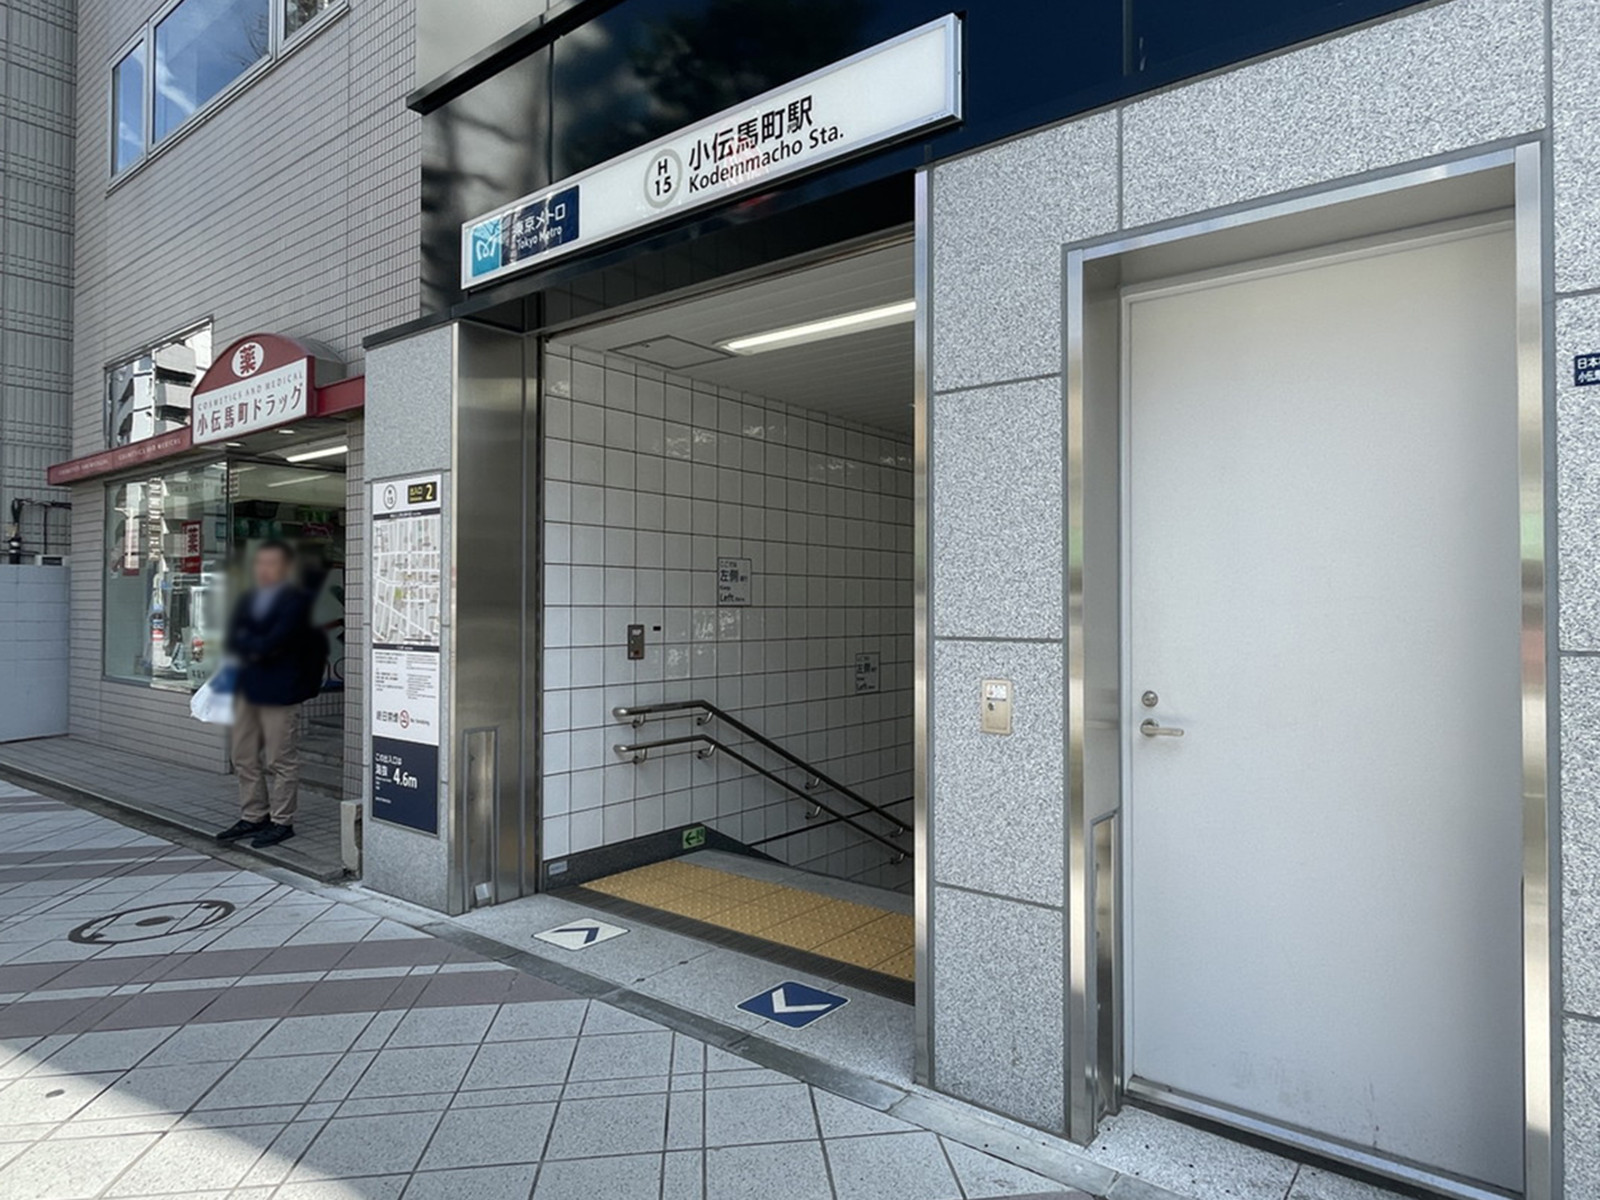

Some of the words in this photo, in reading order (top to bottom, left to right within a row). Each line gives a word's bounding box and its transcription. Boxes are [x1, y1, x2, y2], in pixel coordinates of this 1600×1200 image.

[688, 95, 813, 172] 小伝馬町駅
[657, 159, 668, 177] H
[689, 139, 803, 193] Kodemmacho
[809, 126, 844, 149] Sta.
[655, 176, 673, 196] 15
[513, 203, 566, 238] 東京メトロ
[516, 233, 538, 252] Tokyo
[539, 226, 562, 244] Metro
[239, 344, 256, 375] 薬
[197, 391, 242, 412] COSMETICS
[245, 384, 262, 397] AND
[265, 371, 303, 389] MEDICAL
[197, 382, 303, 436] 小伝馬町ドラッグ
[425, 484, 433, 500] 2
[393, 768, 418, 789] 4.6m
